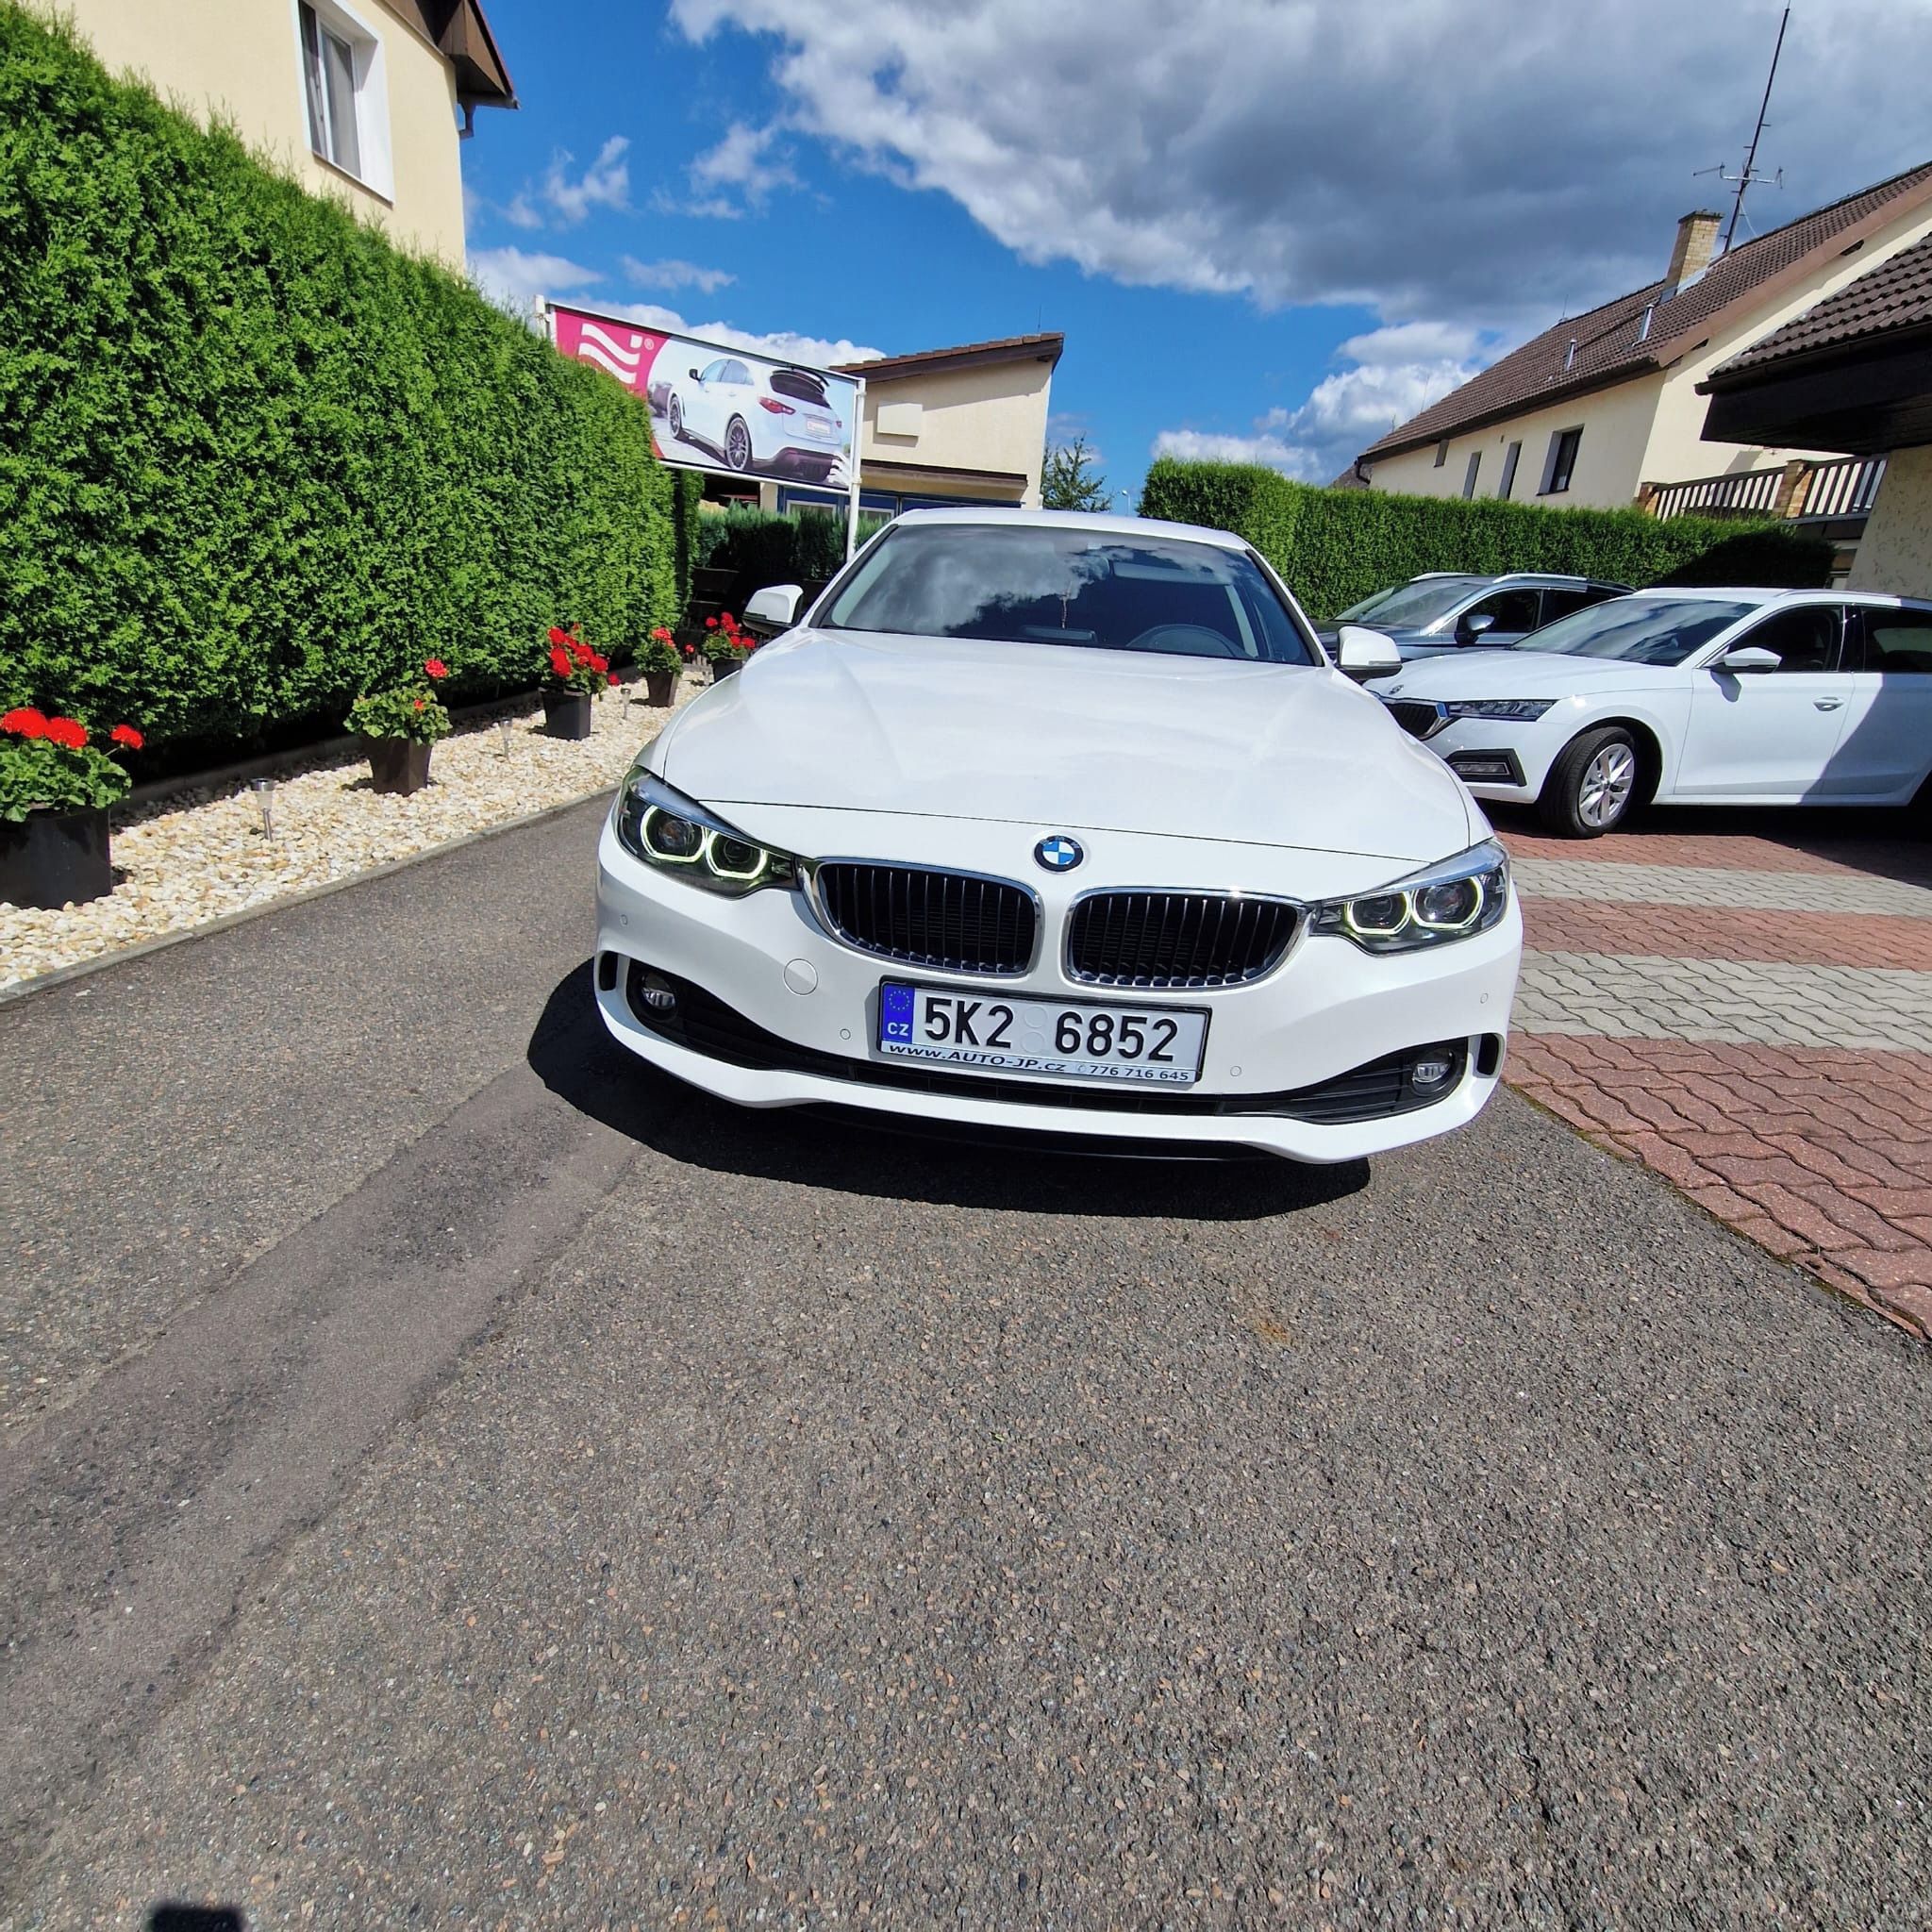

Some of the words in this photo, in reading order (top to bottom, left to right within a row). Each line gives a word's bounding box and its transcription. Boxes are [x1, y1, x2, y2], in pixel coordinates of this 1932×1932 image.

[887, 1021, 909, 1037] CZ
[924, 997, 1014, 1049] 5K2
[1055, 1011, 1178, 1062] 6852
[1090, 1065, 1118, 1076] 776
[1124, 1067, 1154, 1079] 716
[1159, 1070, 1190, 1082] 645
